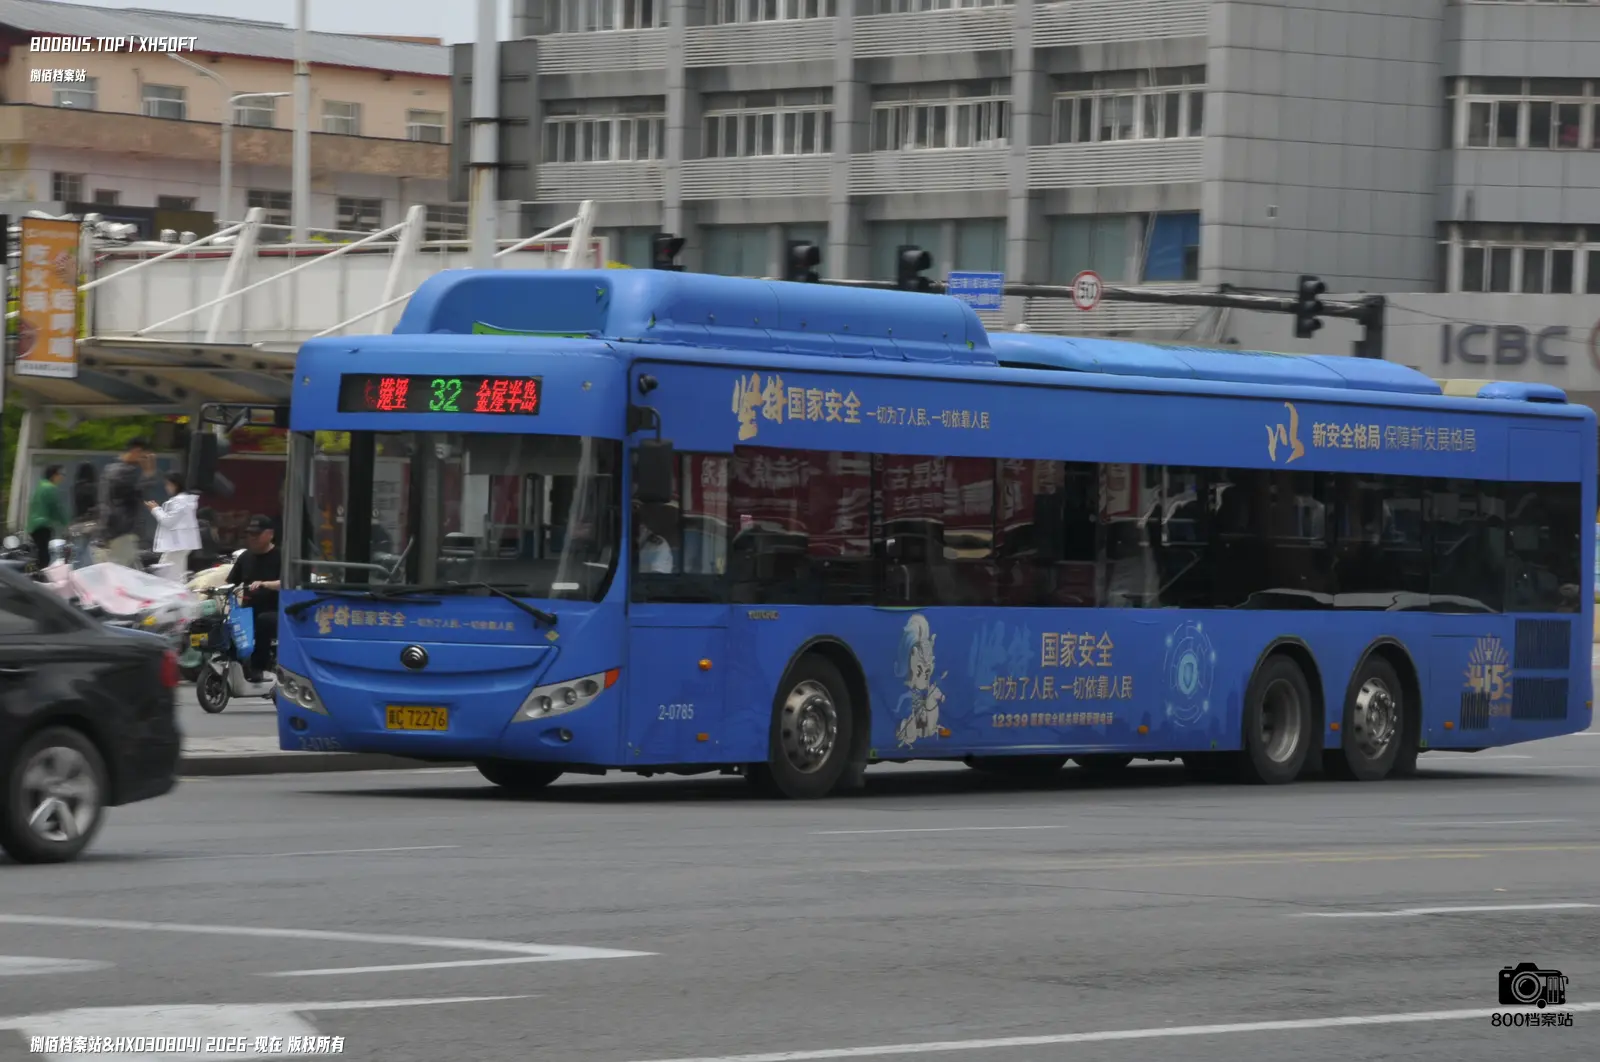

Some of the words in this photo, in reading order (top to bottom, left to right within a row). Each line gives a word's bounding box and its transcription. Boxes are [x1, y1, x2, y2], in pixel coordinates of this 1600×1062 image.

[1441, 324, 1569, 365] ICBC
[429, 379, 463, 411] 32
[787, 387, 861, 424] 国家安全
[866, 406, 990, 429] 一切为了人民、一切依靠人民
[1312, 422, 1381, 449] 新安全格局
[1384, 425, 1477, 452] 保障新发展格局
[351, 610, 406, 627] 国家安全
[1041, 631, 1114, 668] 国家安全
[979, 675, 1133, 700] 一切为了人民、一切依靠人民
[407, 709, 446, 728] 72276
[658, 704, 694, 720] 2-0785
[992, 713, 1028, 728] 12339
